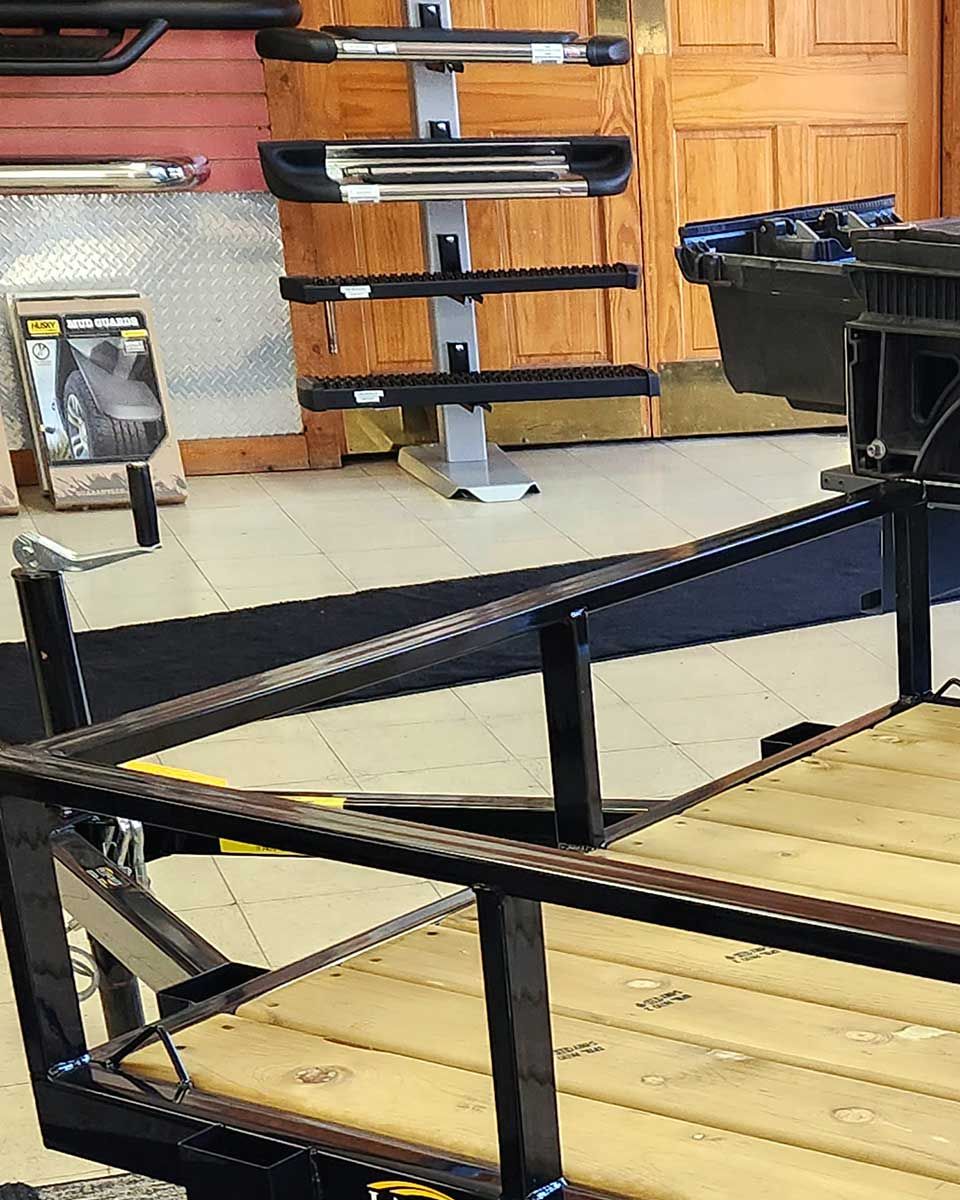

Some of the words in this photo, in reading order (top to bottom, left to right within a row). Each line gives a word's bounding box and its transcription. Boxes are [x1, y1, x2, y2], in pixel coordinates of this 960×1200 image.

[31, 321, 56, 330] HUSKY
[66, 318, 93, 329] MUD
[94, 316, 139, 328] GUARDS
